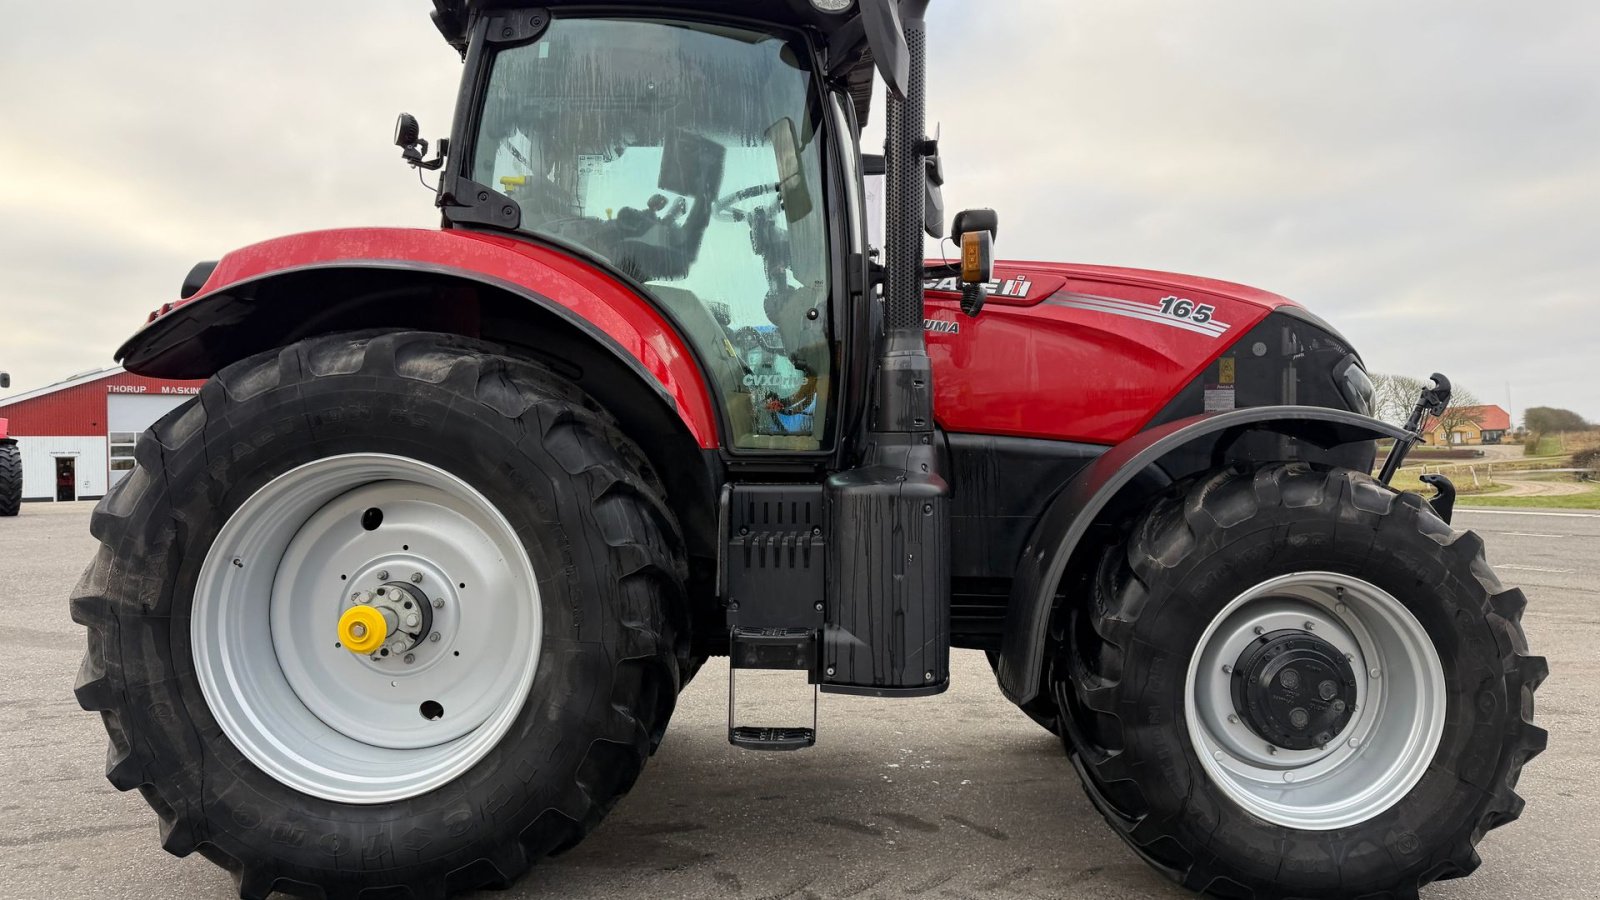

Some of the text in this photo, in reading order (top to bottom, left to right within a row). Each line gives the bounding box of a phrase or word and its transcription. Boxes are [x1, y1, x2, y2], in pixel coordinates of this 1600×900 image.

[1160, 296, 1215, 323] 165
[923, 319, 959, 334] UMA
[743, 373, 808, 386] CVXDrive
[107, 385, 200, 394] THORUP MASKIN
